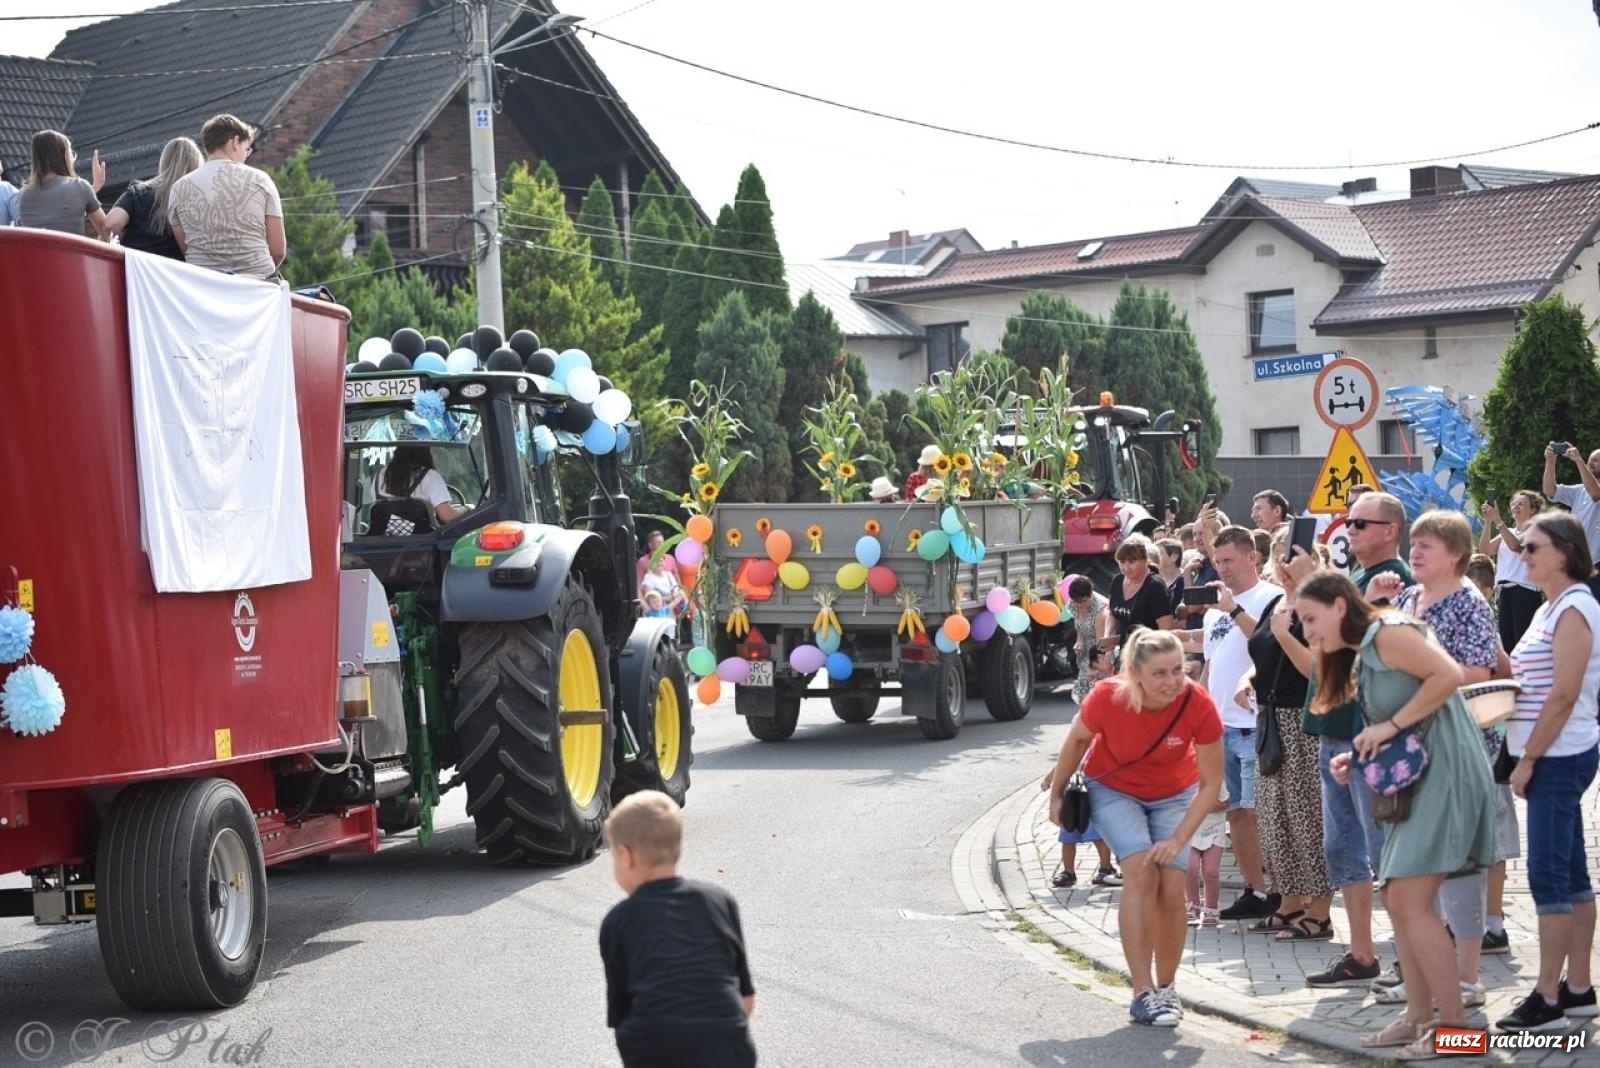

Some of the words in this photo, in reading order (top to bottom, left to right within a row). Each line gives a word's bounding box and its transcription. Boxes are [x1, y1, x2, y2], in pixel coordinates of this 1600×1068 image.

[345, 382, 373, 399] SRC
[379, 379, 417, 396] SH25
[1332, 535, 1351, 569] 3
